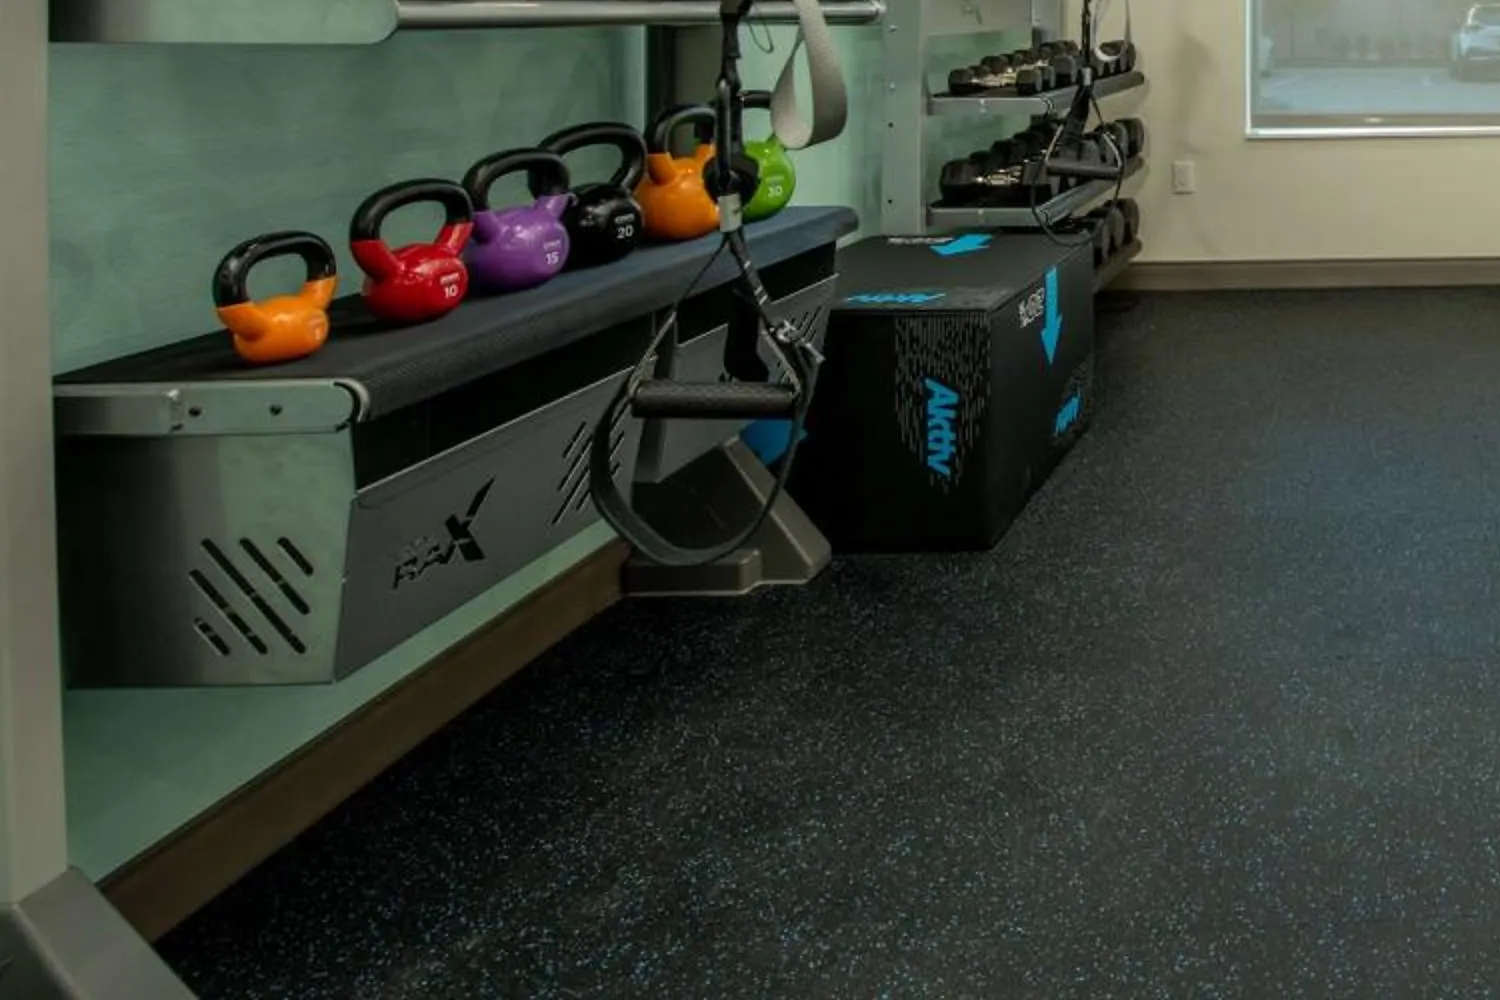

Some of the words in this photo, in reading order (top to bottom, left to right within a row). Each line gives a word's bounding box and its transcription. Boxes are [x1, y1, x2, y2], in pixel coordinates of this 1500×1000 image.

[616, 224, 634, 239] 20
[545, 251, 560, 265] 15
[444, 283, 460, 299] 10
